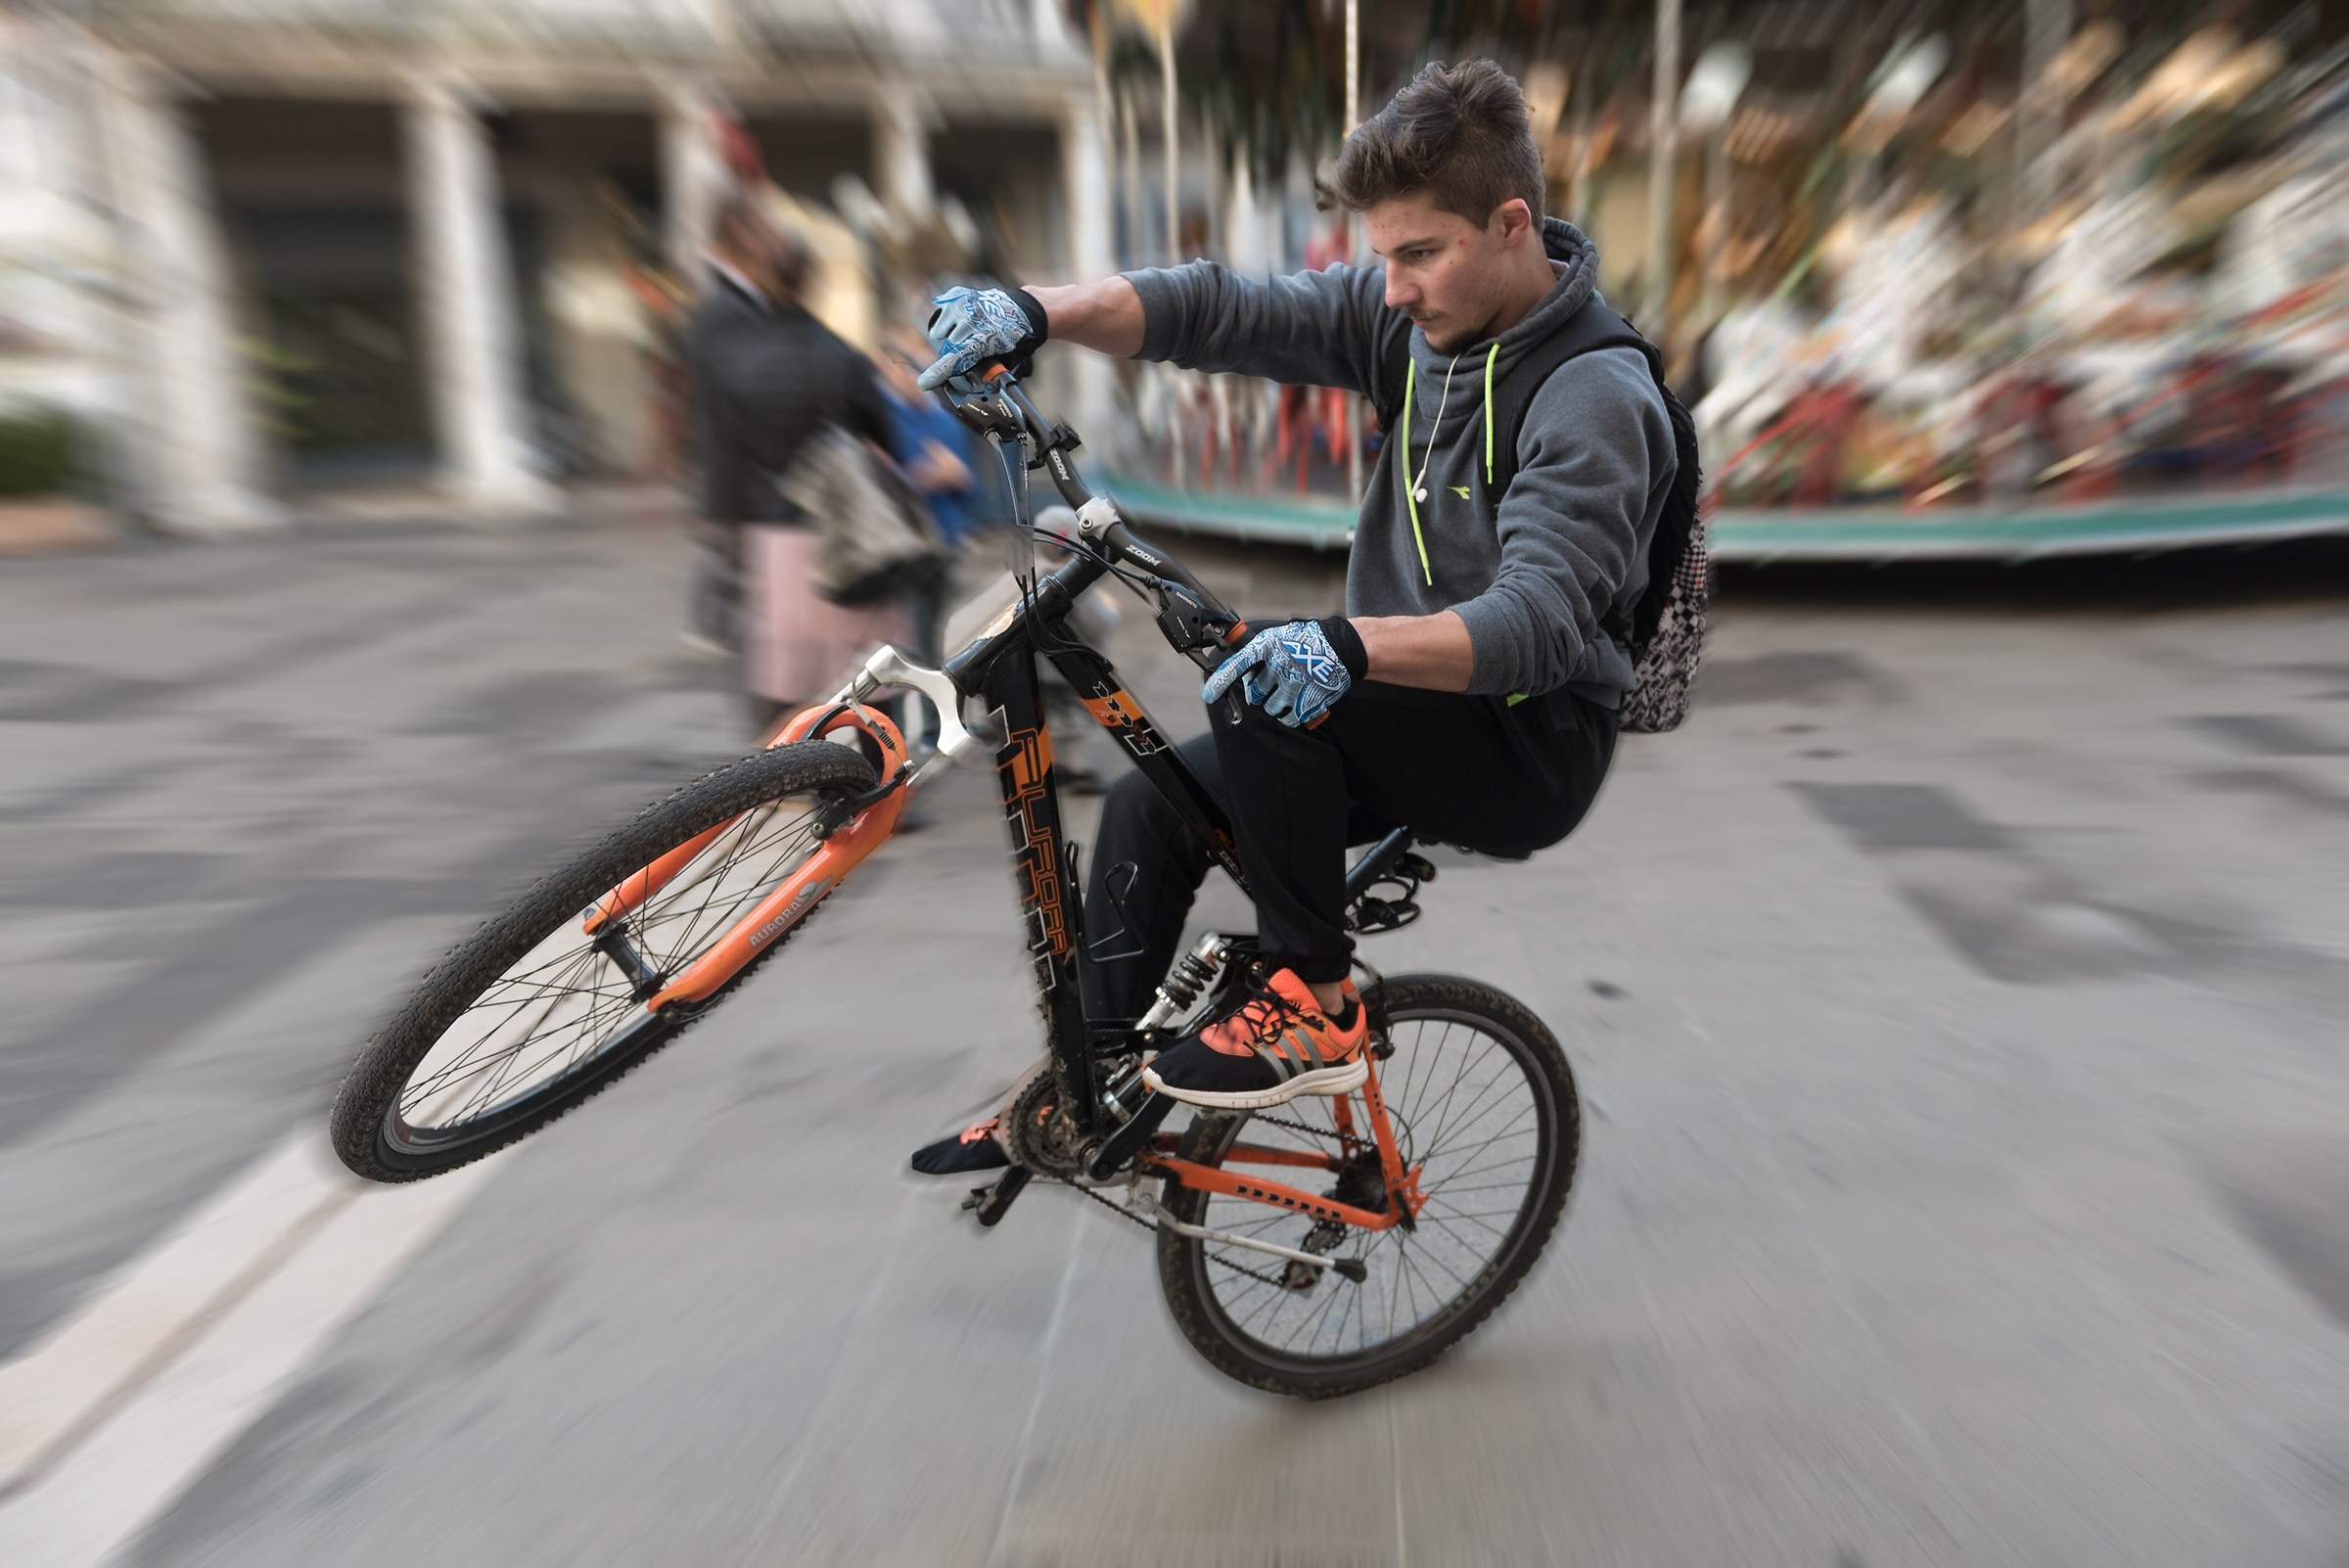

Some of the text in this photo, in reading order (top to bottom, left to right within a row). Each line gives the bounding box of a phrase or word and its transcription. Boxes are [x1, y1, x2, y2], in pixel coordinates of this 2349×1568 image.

[1049, 447, 1071, 482] ZOOM
[1126, 544, 1162, 567] ZOOM
[1175, 591, 1198, 609] SHIMANO
[1282, 640, 1336, 683] AXE
[1011, 727, 1069, 956] AURORA
[749, 899, 802, 947] AURORA
